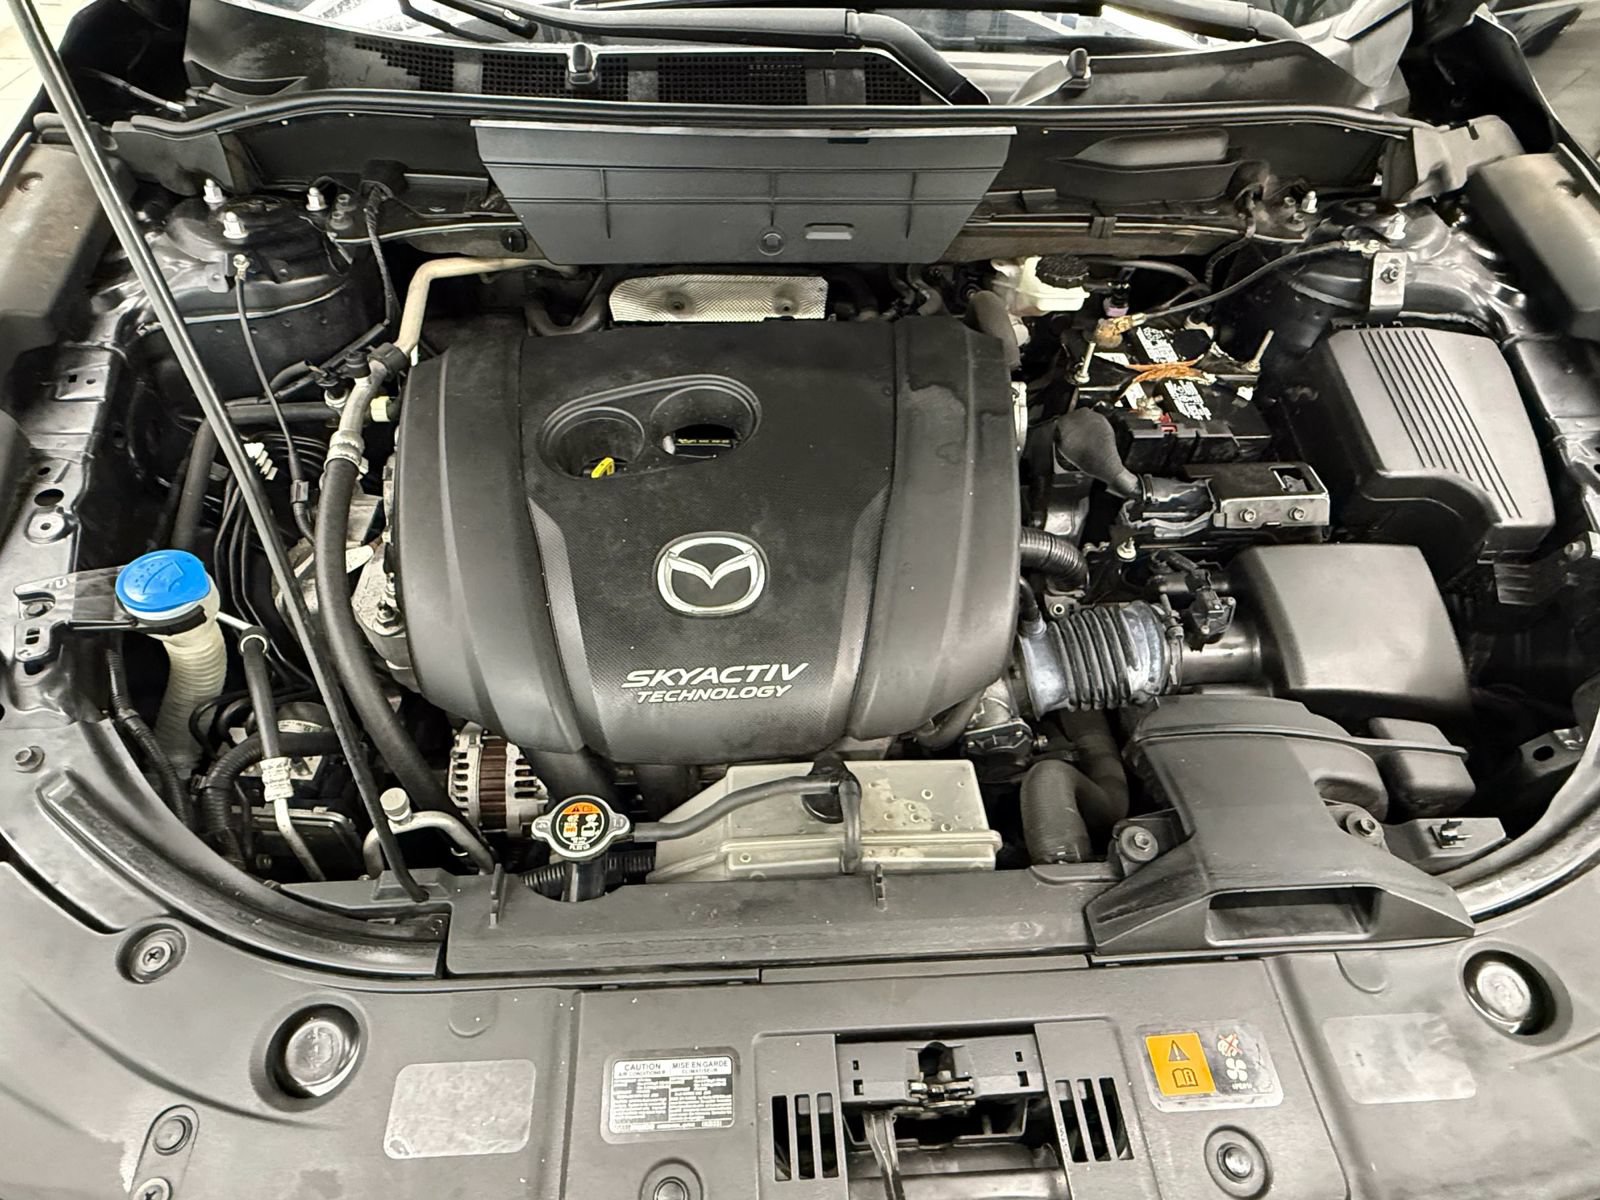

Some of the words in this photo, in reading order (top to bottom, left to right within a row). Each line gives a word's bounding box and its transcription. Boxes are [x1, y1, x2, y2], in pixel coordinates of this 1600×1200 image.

[621, 662, 809, 688] SKYACTIV
[637, 684, 793, 704] TECHNOLOGY
[672, 1061, 690, 1069] MISE
